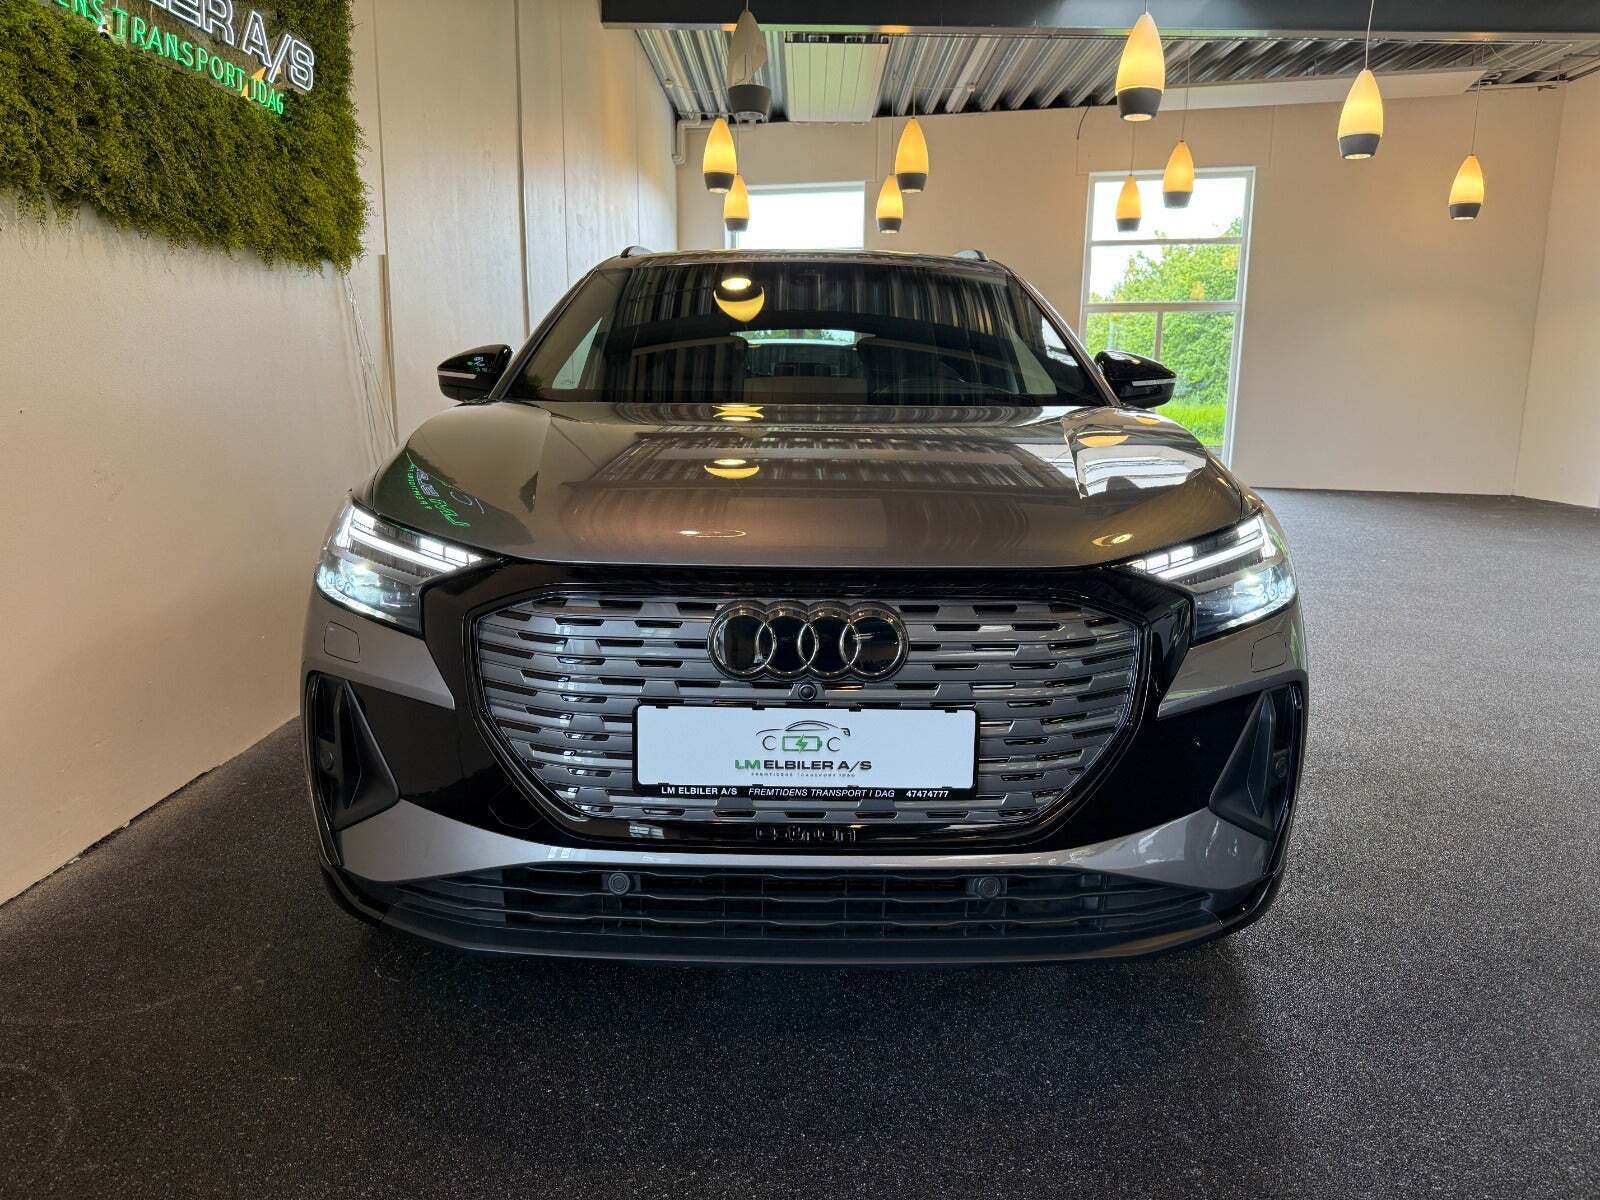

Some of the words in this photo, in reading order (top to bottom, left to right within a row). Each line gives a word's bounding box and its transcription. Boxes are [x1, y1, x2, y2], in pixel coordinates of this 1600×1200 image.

[111, 7, 246, 92] TRANSPORT
[242, 10, 315, 91] A/S
[763, 759, 834, 770] ELBILER
[837, 760, 872, 773] A/S
[661, 786, 676, 795] LM
[678, 786, 719, 796] ELBILER
[720, 787, 738, 796] A/S
[748, 788, 808, 797] FREMTIDENS
[810, 788, 868, 798] TRANSPORT
[874, 789, 896, 798] DAG
[905, 790, 949, 798] 47474777
